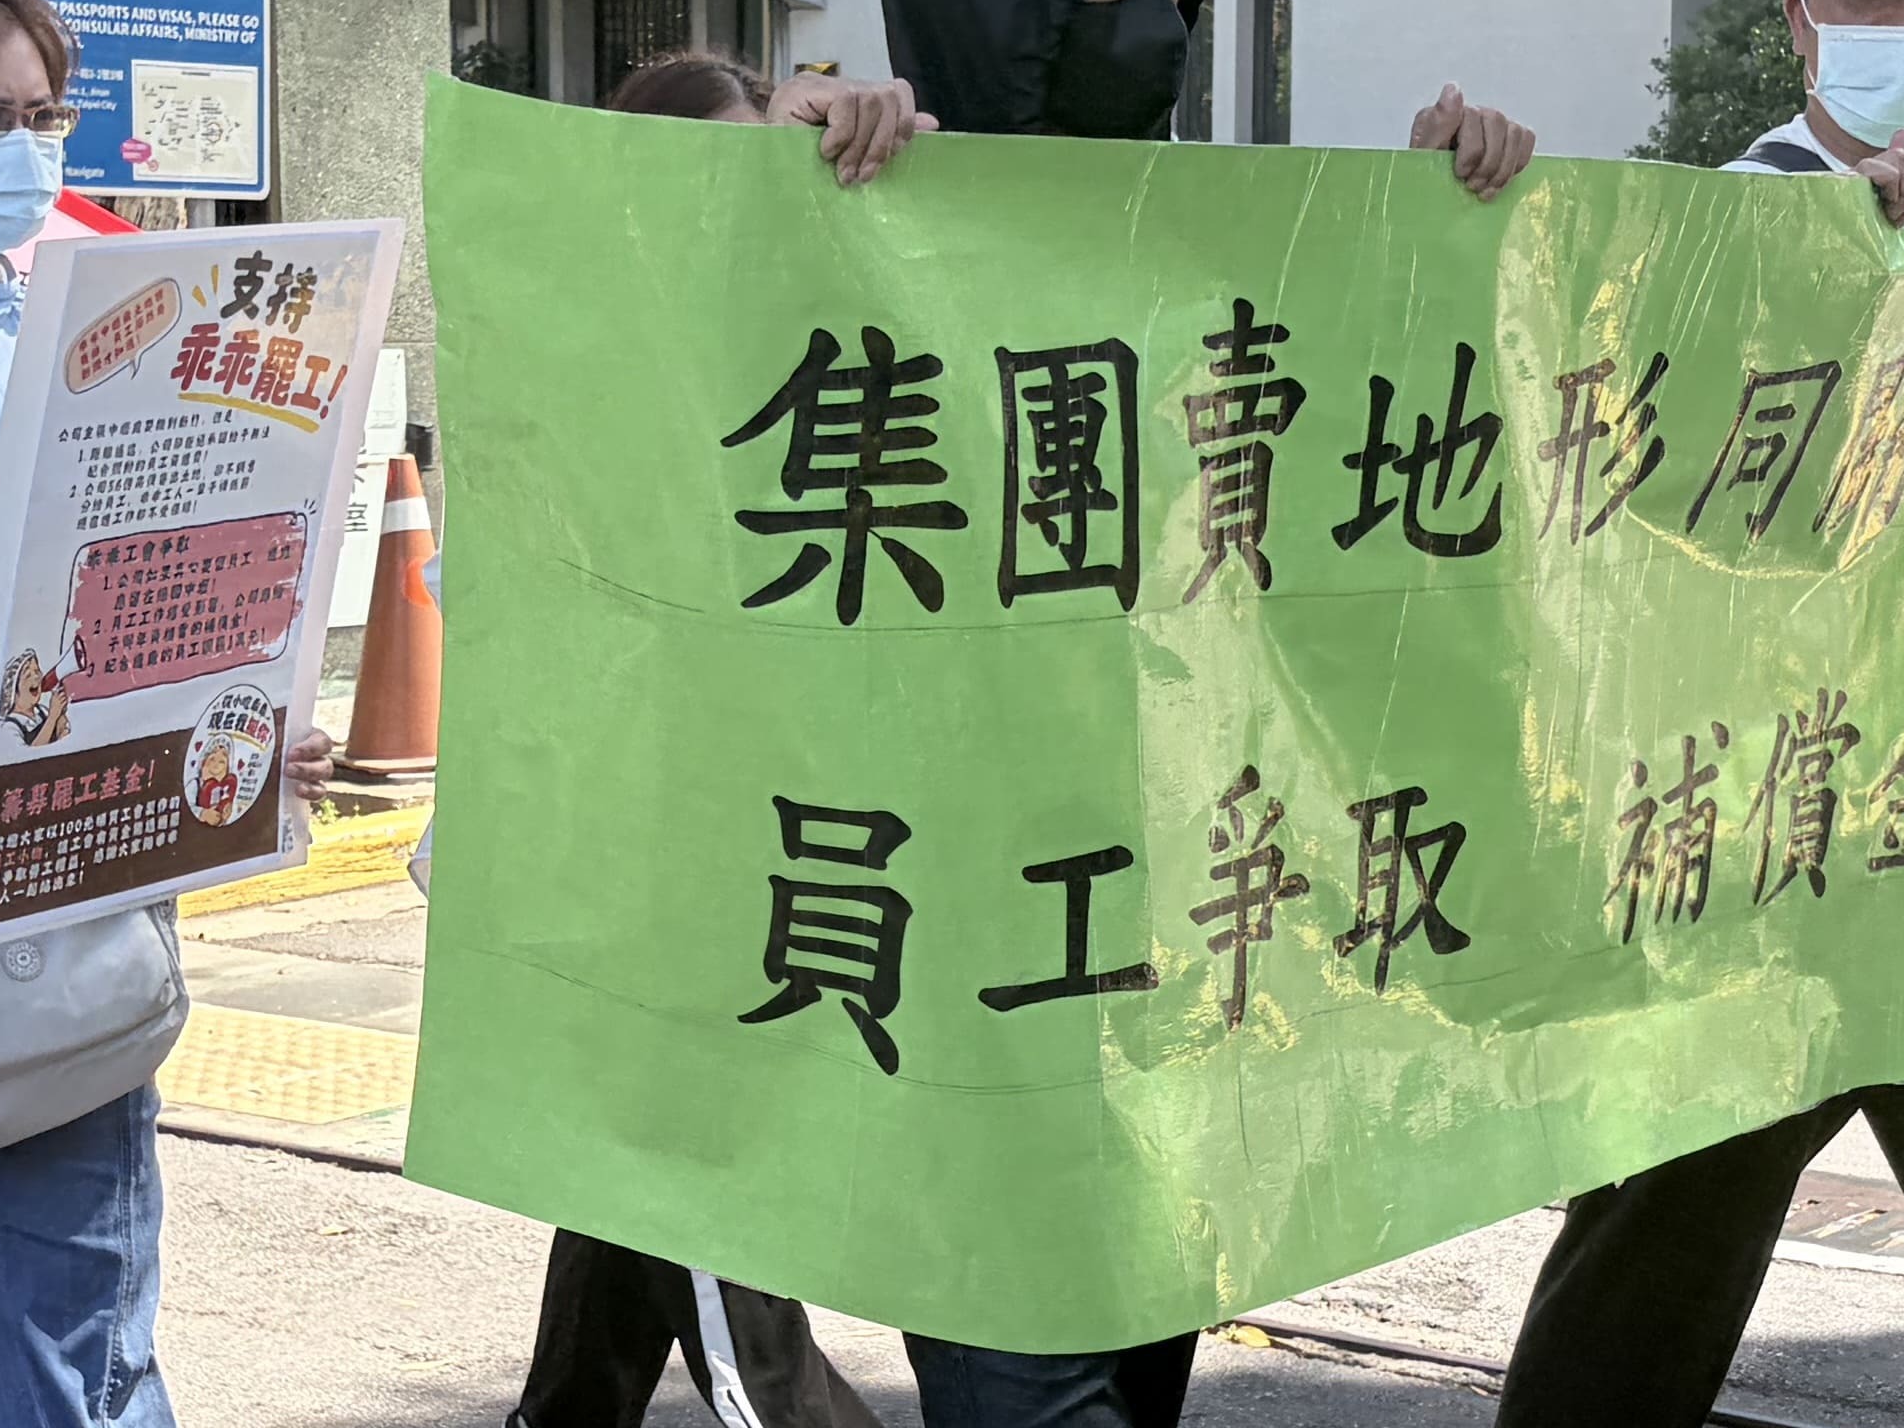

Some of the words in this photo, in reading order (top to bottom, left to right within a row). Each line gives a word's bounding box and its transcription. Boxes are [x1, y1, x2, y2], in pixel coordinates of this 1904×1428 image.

[60, 1, 129, 20] PASSPORTS
[131, 6, 157, 21] AND
[158, 9, 196, 26] VISAS,
[198, 11, 239, 27] PLEASE
[241, 15, 260, 29] GO
[131, 22, 183, 41] AFFAIRS,
[185, 27, 239, 44] MINISTRY
[240, 31, 257, 44] OF
[221, 250, 318, 333] 支持
[170, 322, 349, 420] 乖乖罷工!
[736, 763, 1472, 1077] 員工爭取
